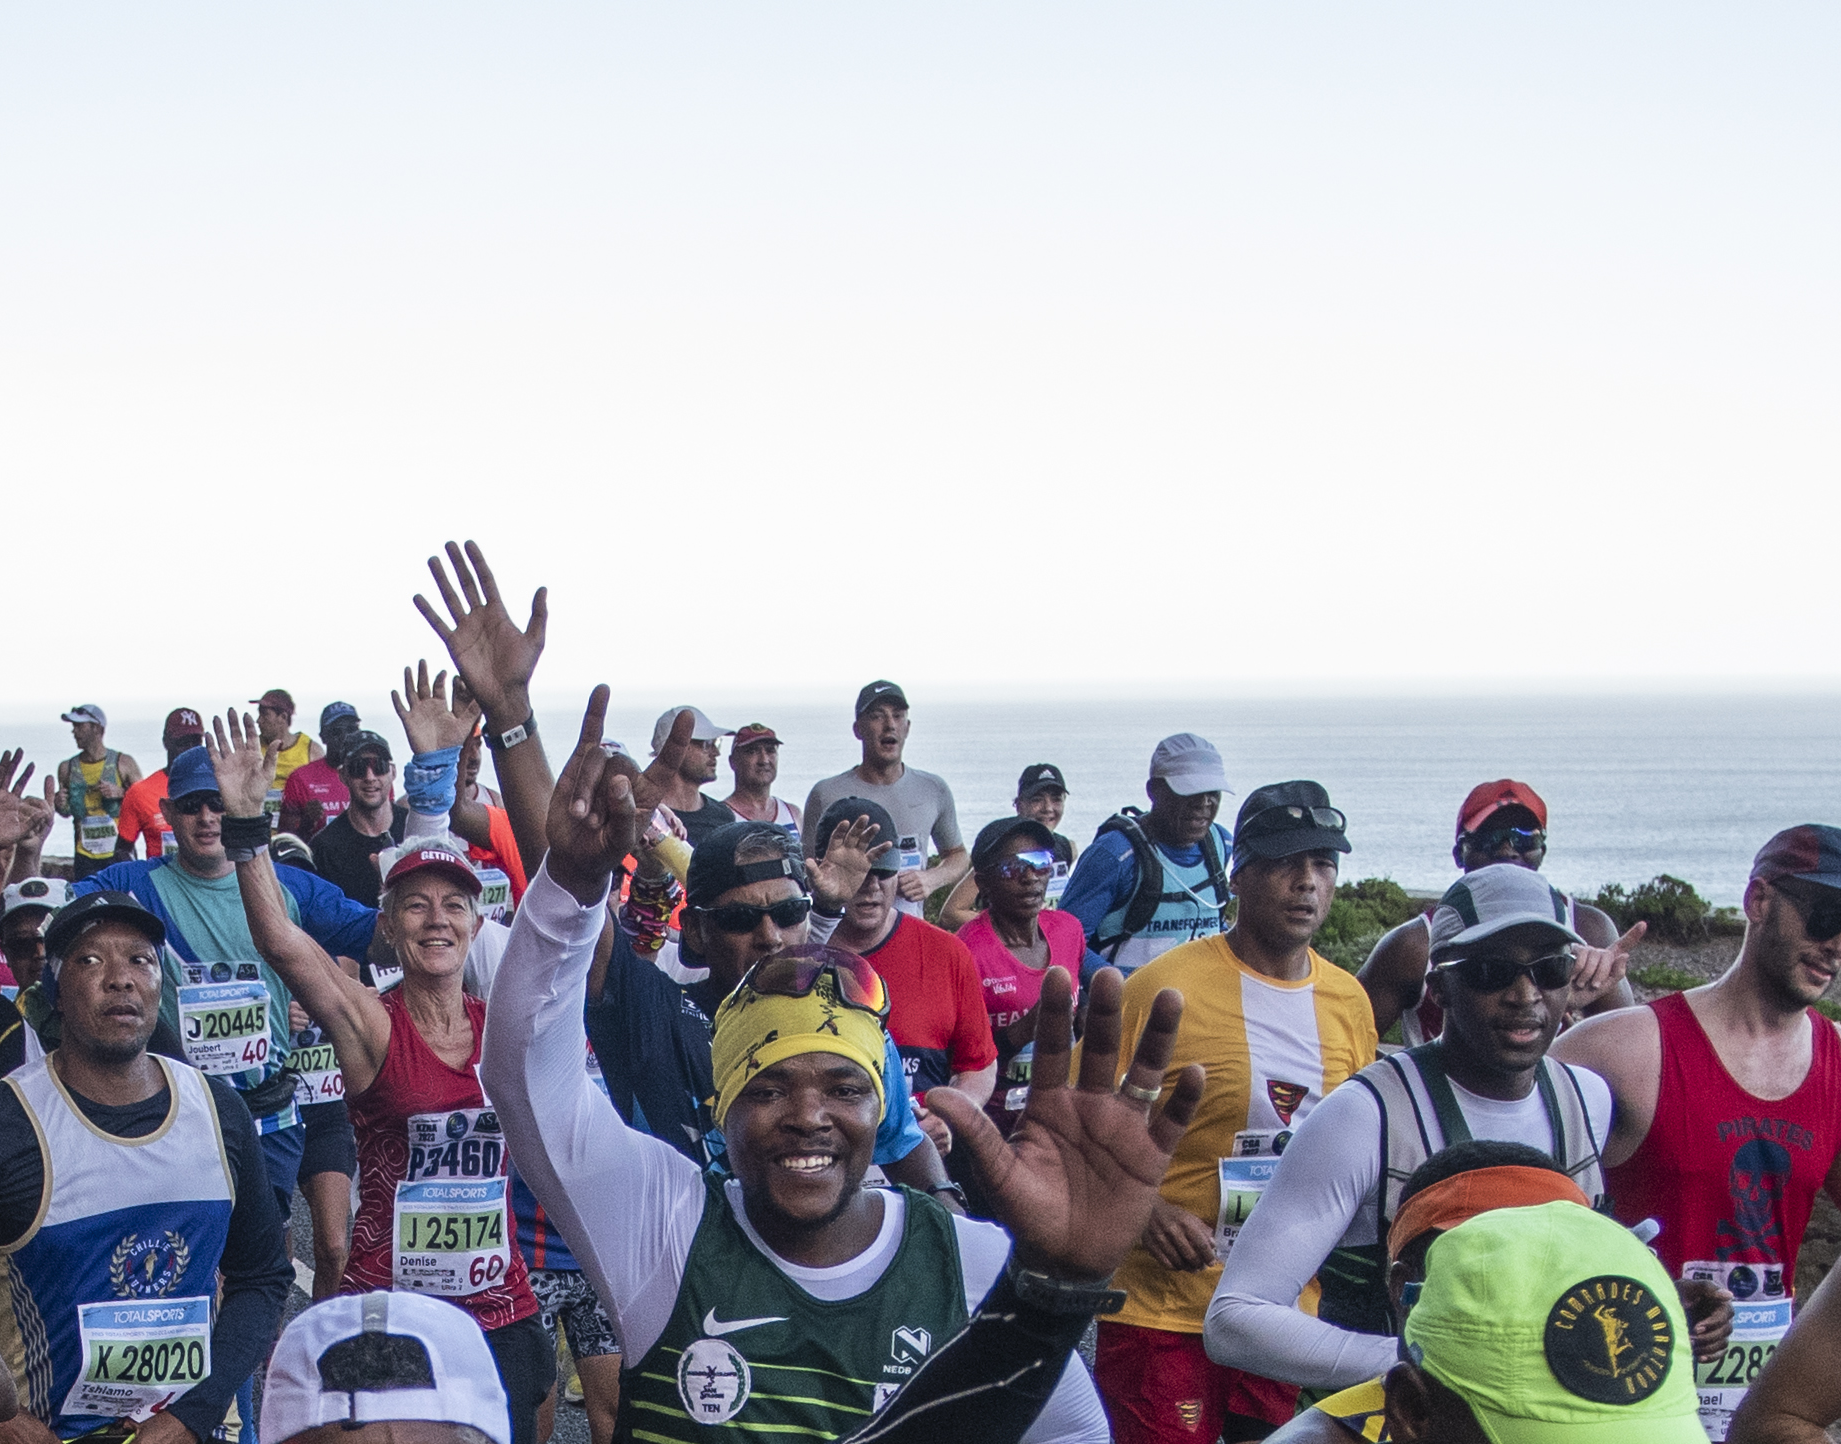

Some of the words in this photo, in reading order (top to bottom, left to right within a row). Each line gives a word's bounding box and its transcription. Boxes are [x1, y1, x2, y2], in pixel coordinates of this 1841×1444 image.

[187, 1019, 202, 1039] J
[205, 1006, 265, 1039] 20445
[188, 1044, 222, 1055] Joubert
[242, 1038, 268, 1065] 40
[321, 1073, 344, 1097] 40
[1716, 1117, 1815, 1151] PIRATES
[409, 1140, 502, 1182] P3460
[422, 1187, 488, 1199] TOTALSPORTS
[407, 1217, 418, 1249] J
[425, 1213, 502, 1250] 25174
[400, 1256, 437, 1267] Denise
[469, 1254, 504, 1287] 60
[113, 1309, 185, 1324] TOTALSPORTS
[1554, 1282, 1644, 1330] COMRADES
[1735, 1310, 1777, 1324] SPORTS
[94, 1345, 114, 1379] K
[115, 1340, 205, 1382] 28020
[883, 1365, 912, 1375] NEDB
[702, 1403, 721, 1413] TEN
